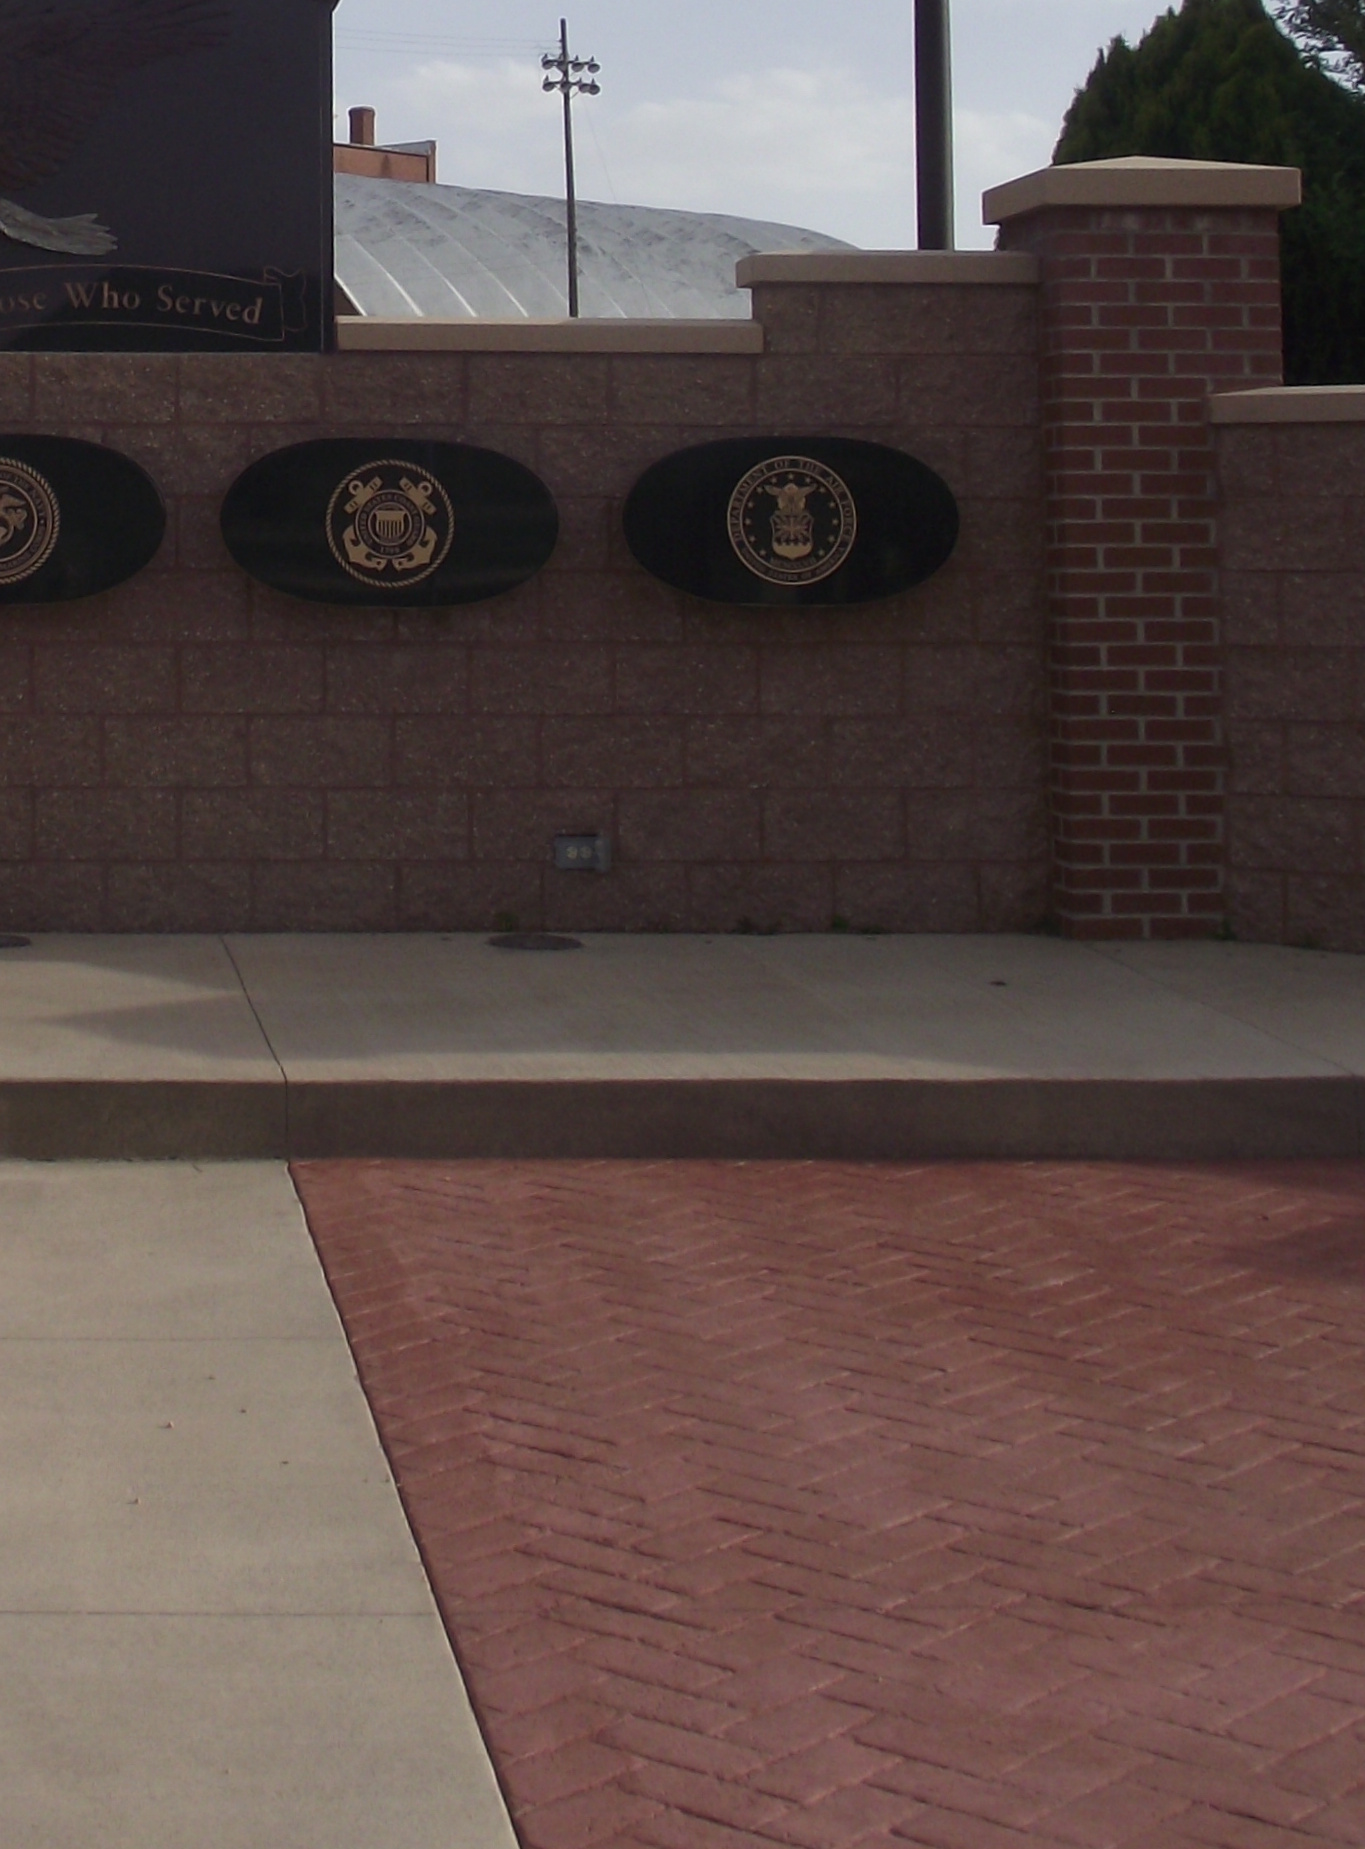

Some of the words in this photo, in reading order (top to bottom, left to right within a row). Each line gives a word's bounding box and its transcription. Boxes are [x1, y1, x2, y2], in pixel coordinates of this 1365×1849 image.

[64, 281, 140, 309] Who
[157, 285, 263, 324] Served
[731, 465, 768, 542] DEPARTMENT
[774, 459, 789, 469] OF
[799, 460, 819, 472] THE
[827, 475, 844, 494] AIR
[842, 499, 853, 543] FORCE
